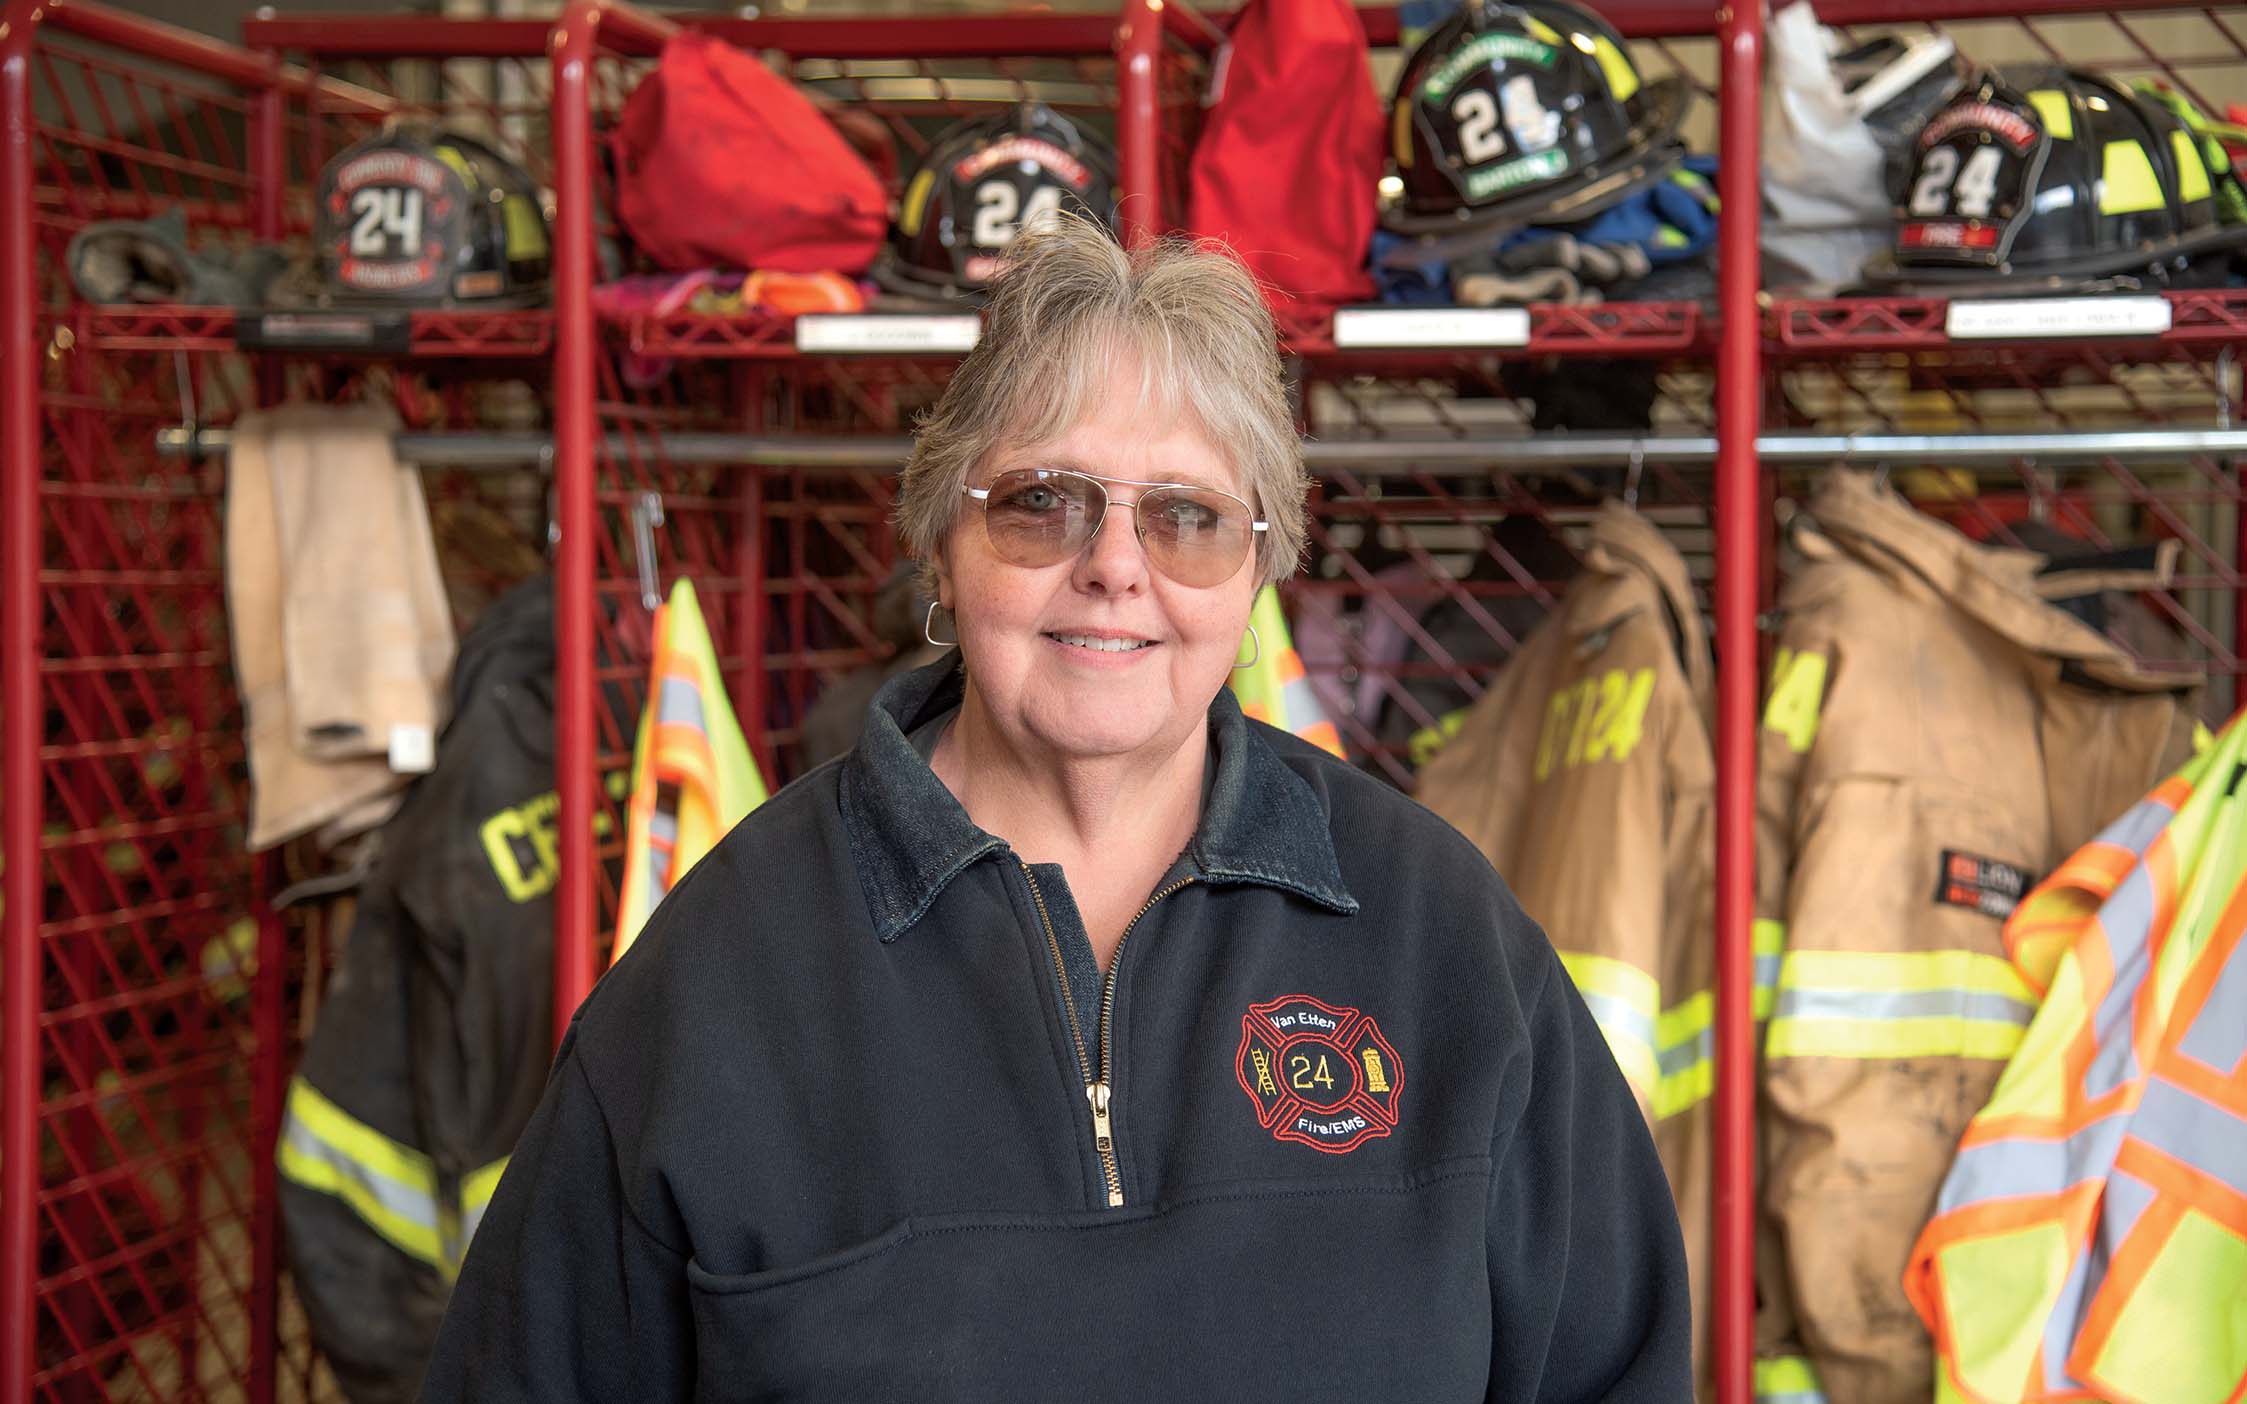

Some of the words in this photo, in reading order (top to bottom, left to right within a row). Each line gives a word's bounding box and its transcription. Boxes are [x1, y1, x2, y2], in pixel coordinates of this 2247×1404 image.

[1452, 73, 1561, 165] 24
[1909, 144, 2003, 217] 24
[350, 187, 423, 257] 24
[1270, 1015, 1296, 1029] Van
[1298, 1012, 1336, 1030] Etten
[1291, 1055, 1335, 1090] 24
[1298, 1116, 1366, 1135] Fire/EMS
